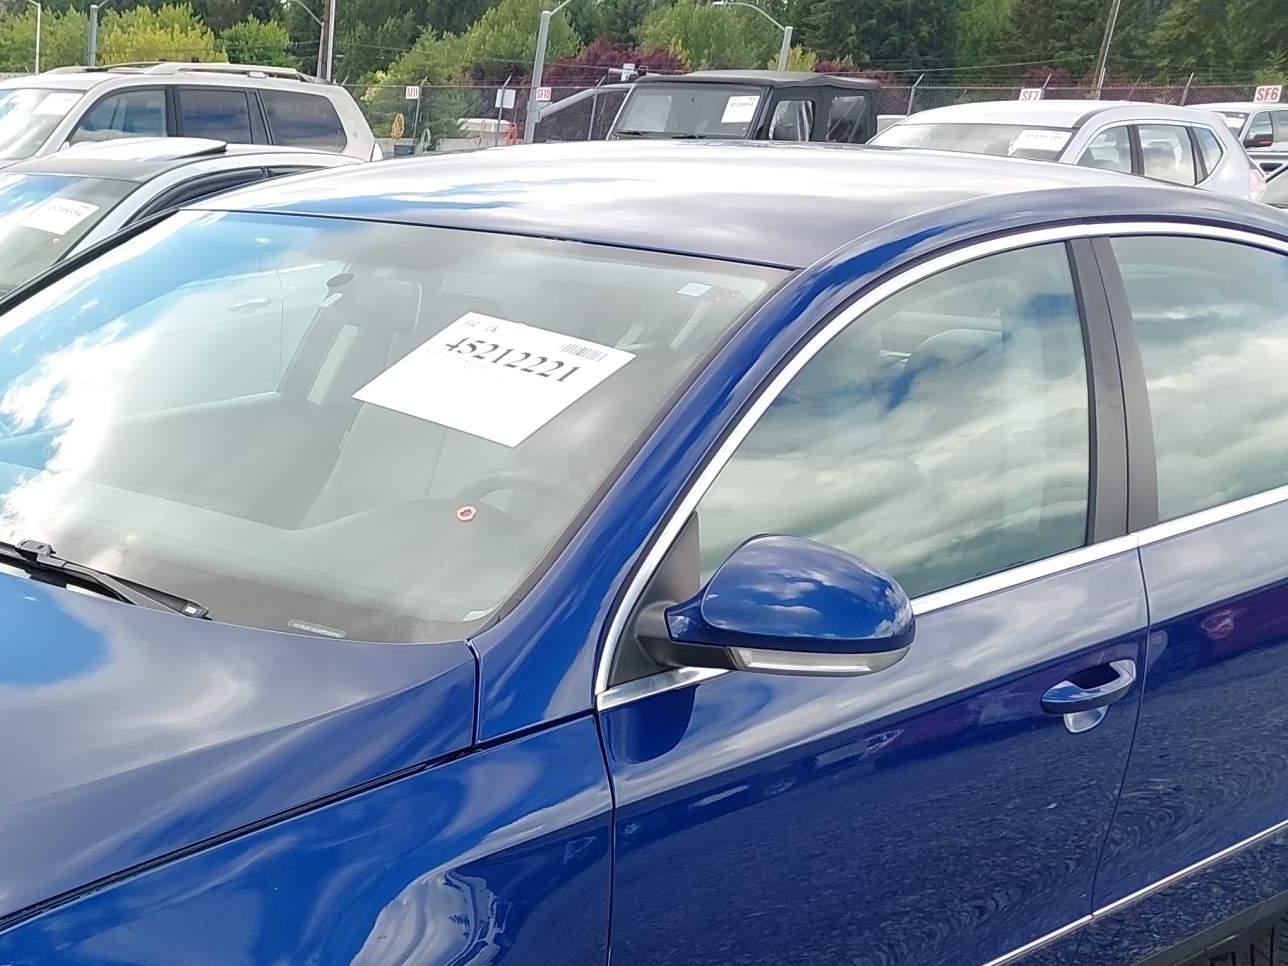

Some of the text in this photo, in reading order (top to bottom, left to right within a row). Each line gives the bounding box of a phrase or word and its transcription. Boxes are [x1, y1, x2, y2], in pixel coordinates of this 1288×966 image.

[1021, 90, 1040, 101] SF7
[1256, 87, 1279, 101] SF6
[445, 336, 581, 383] 45212221
